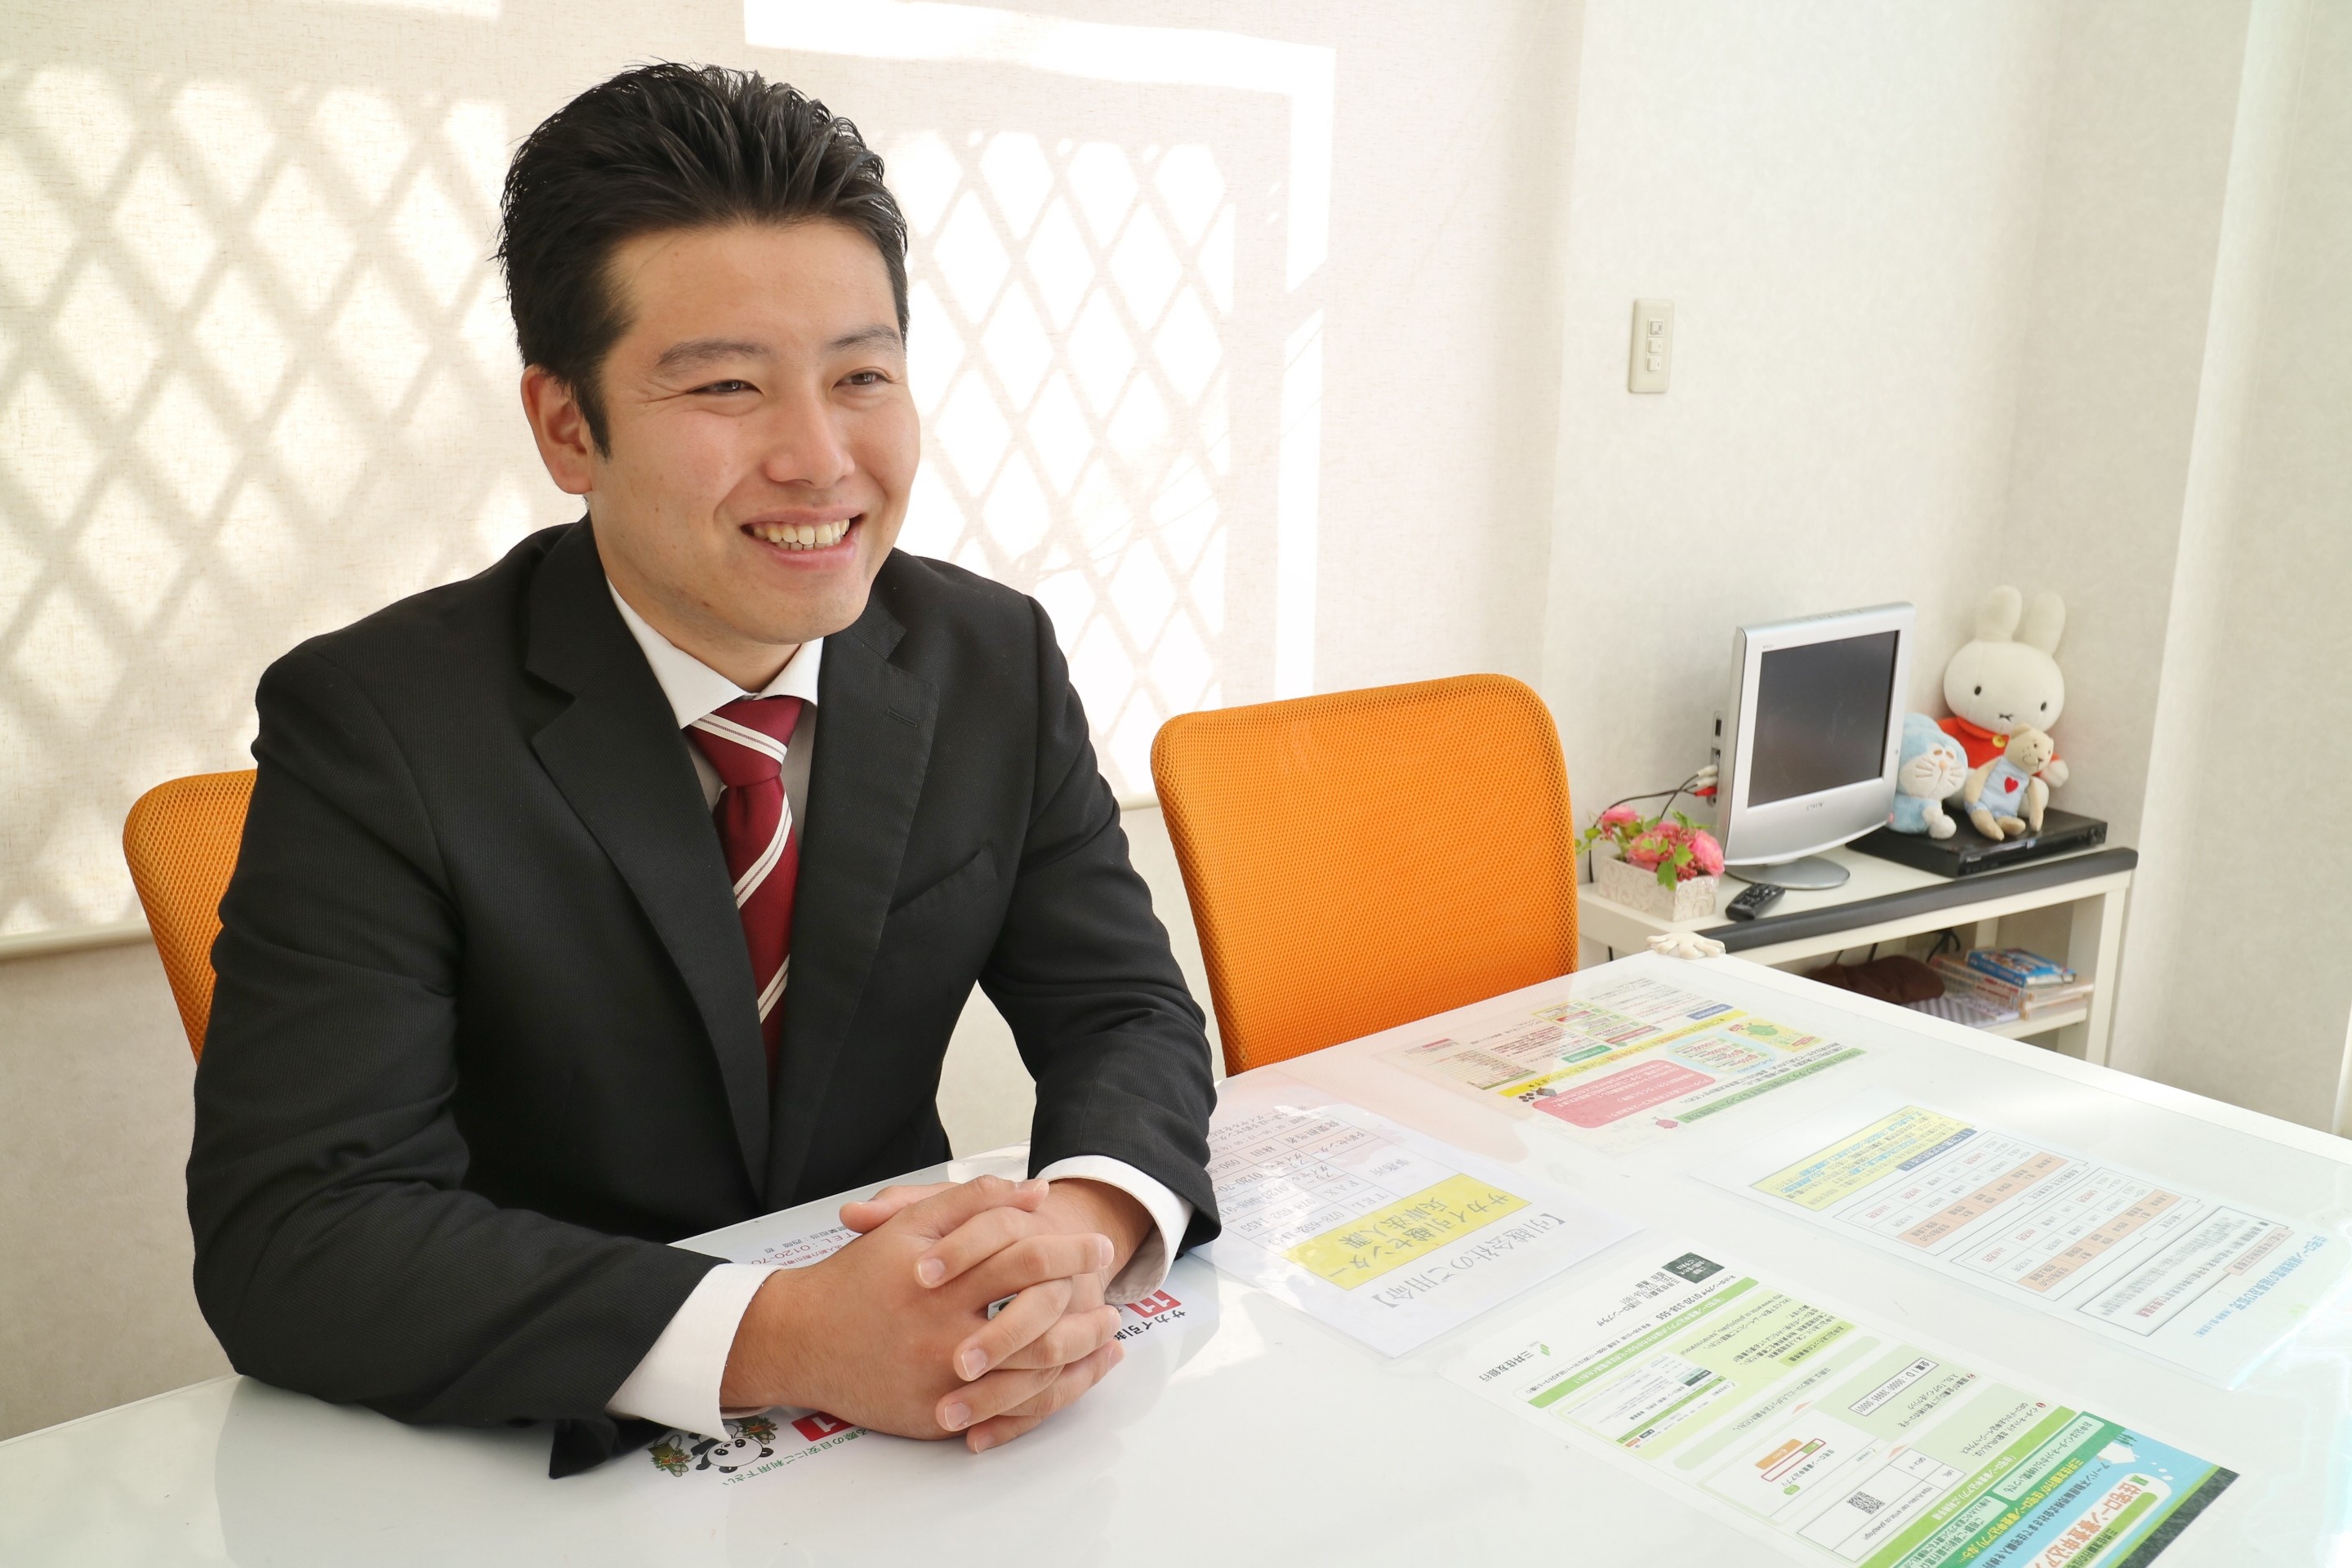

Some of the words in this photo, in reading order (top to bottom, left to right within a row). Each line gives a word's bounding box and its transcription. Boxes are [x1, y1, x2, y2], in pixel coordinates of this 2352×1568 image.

[1328, 1192, 1509, 1276] サカイ引越センター
[1338, 1196, 1449, 1250] 兵庫法人課
[1372, 1213, 1566, 1307] 【引越会社のご用命】
[1474, 1350, 1536, 1382] 三井住友銀行
